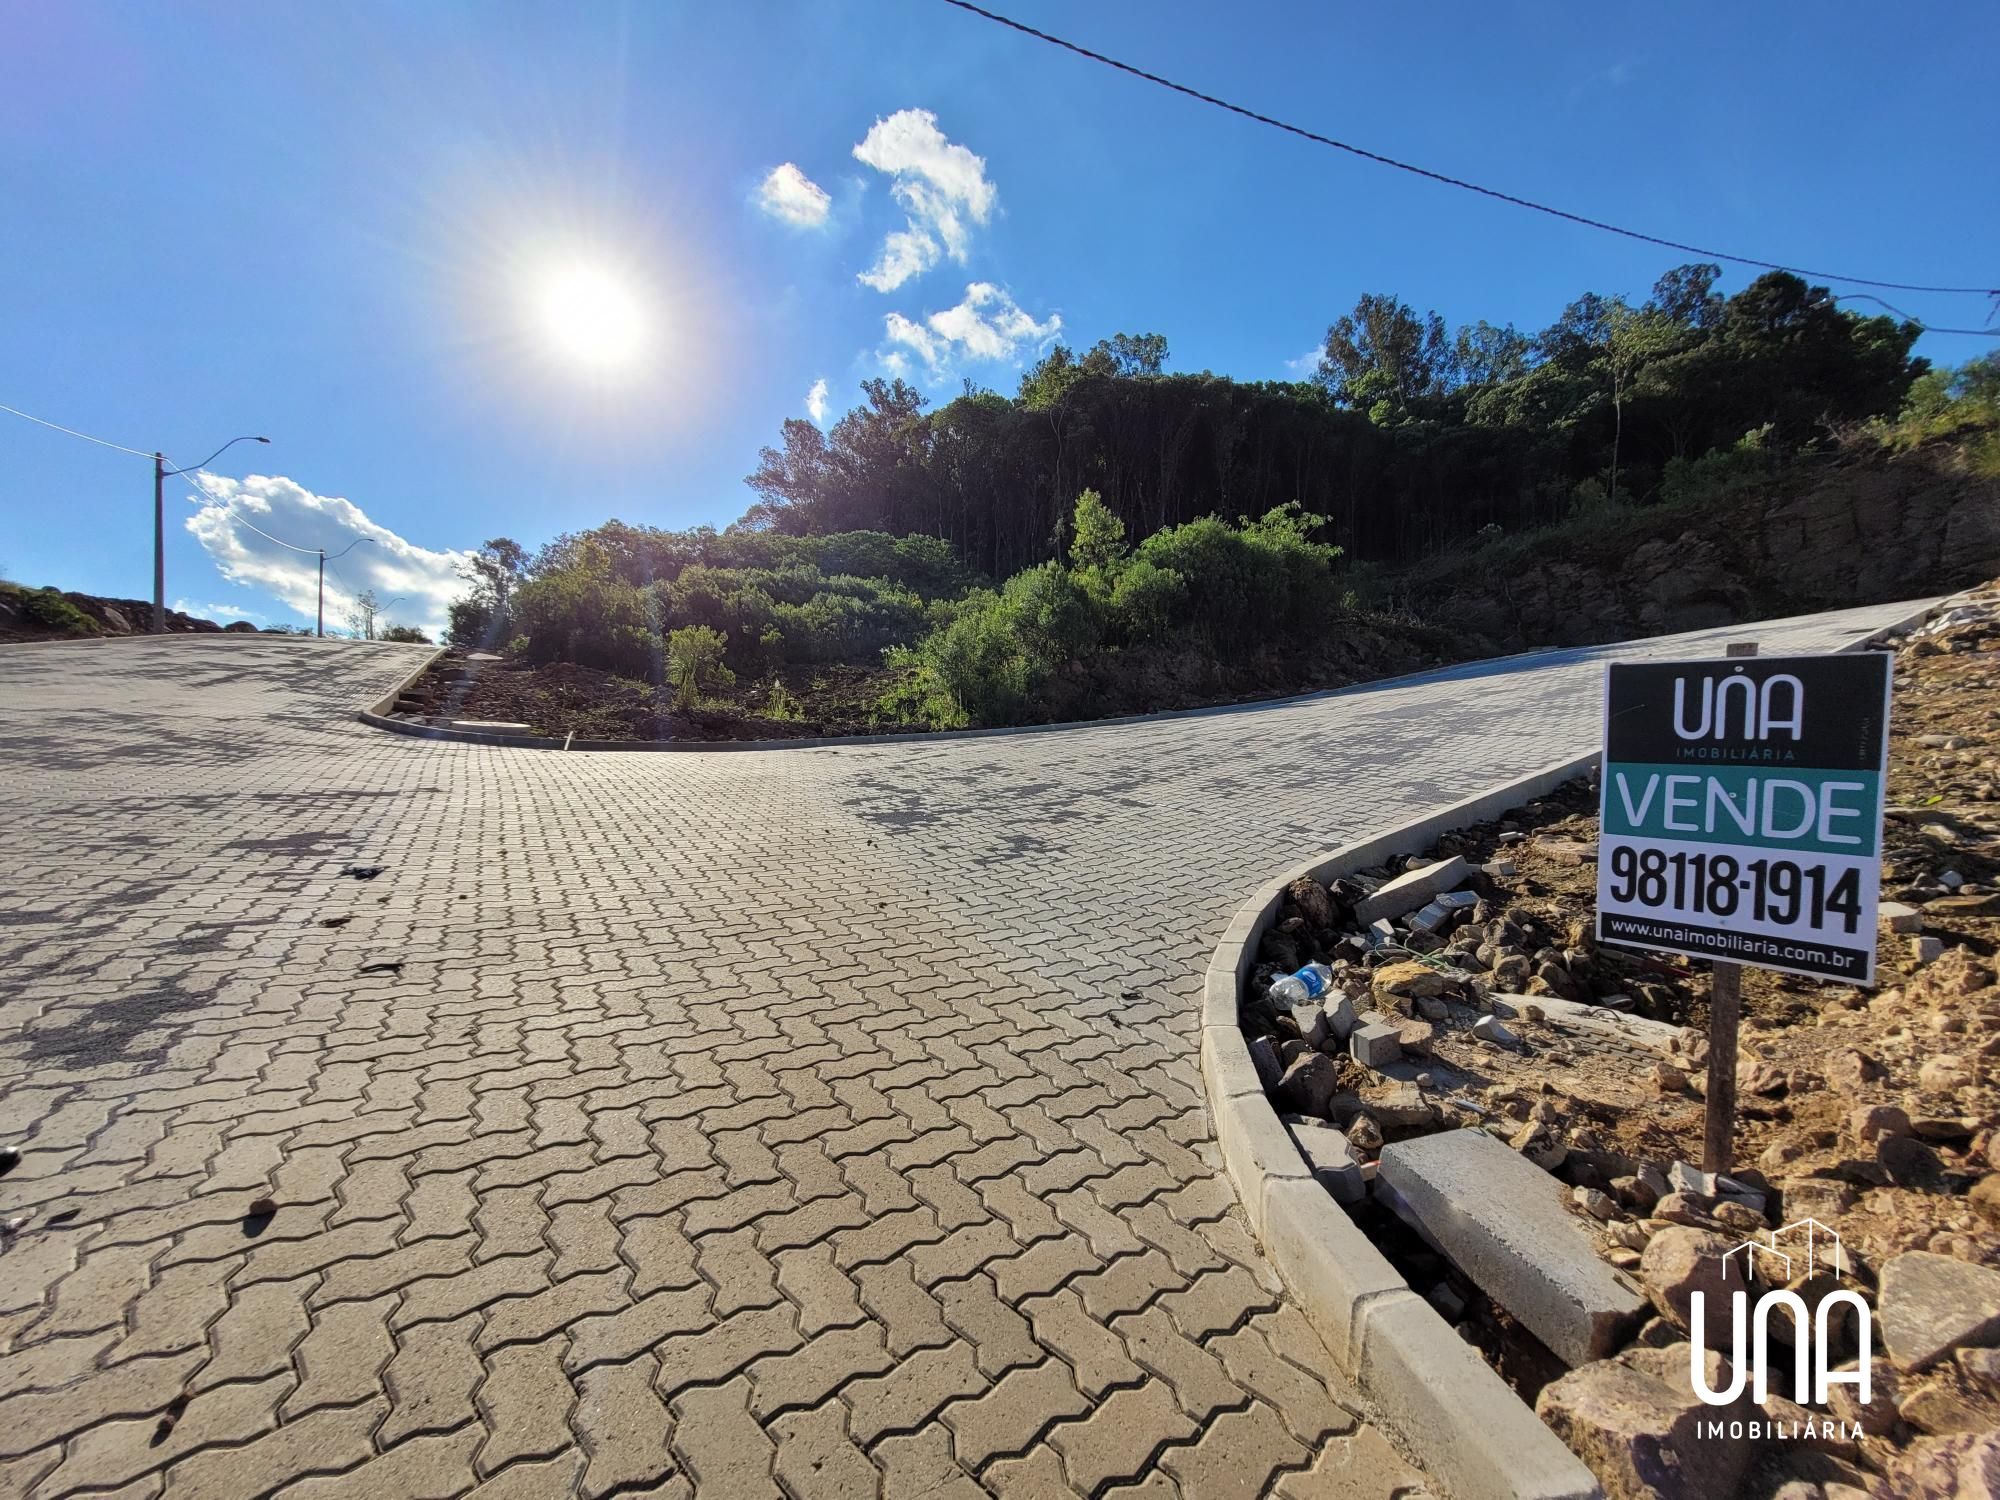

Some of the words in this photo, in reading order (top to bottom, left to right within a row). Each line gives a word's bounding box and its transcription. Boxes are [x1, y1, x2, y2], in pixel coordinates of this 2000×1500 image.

[1674, 674, 1804, 740] UNA
[1676, 746, 1796, 760] IMOBILIÁRIA
[1616, 772, 1866, 844] VENDE
[1610, 845, 1862, 934] 98118-1914
[1611, 919, 1856, 969] www.unaimobiliaria.com.br
